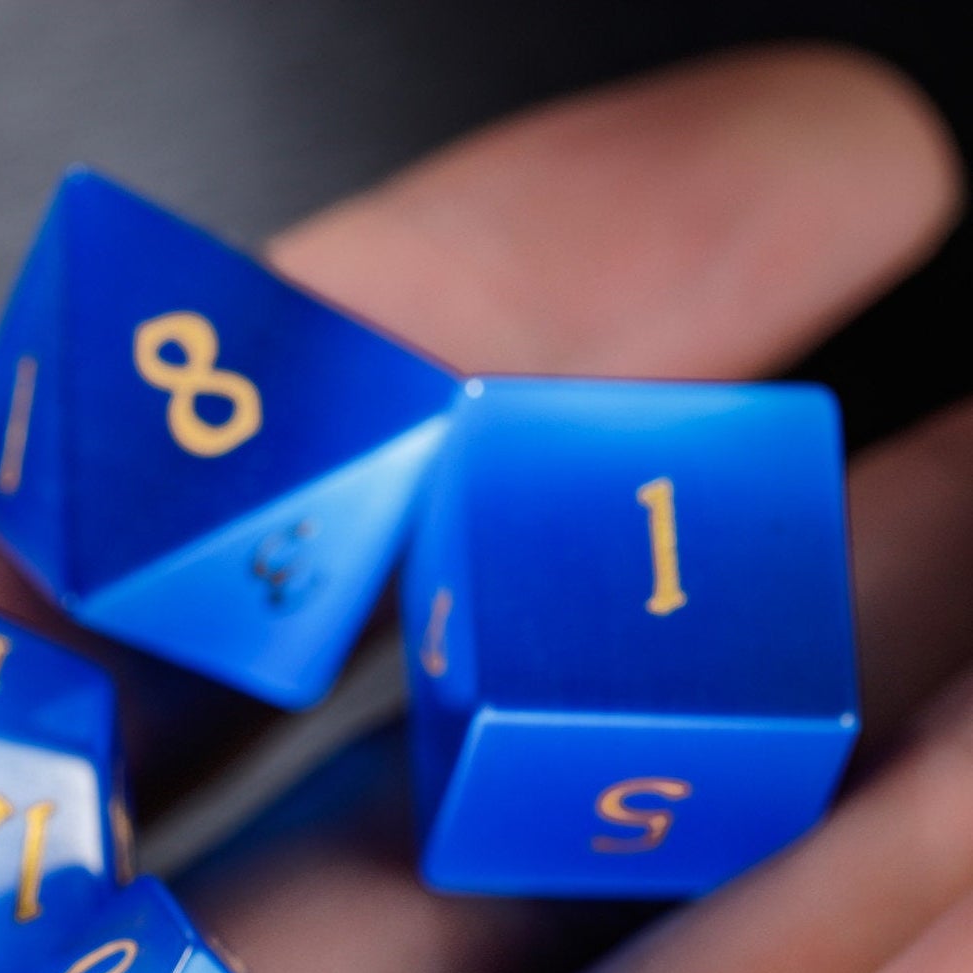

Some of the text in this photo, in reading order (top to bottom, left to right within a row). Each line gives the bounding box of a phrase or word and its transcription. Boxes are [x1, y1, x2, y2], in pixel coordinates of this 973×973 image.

[133, 310, 264, 458] 8
[636, 475, 688, 616] 1
[590, 776, 694, 853] 5
